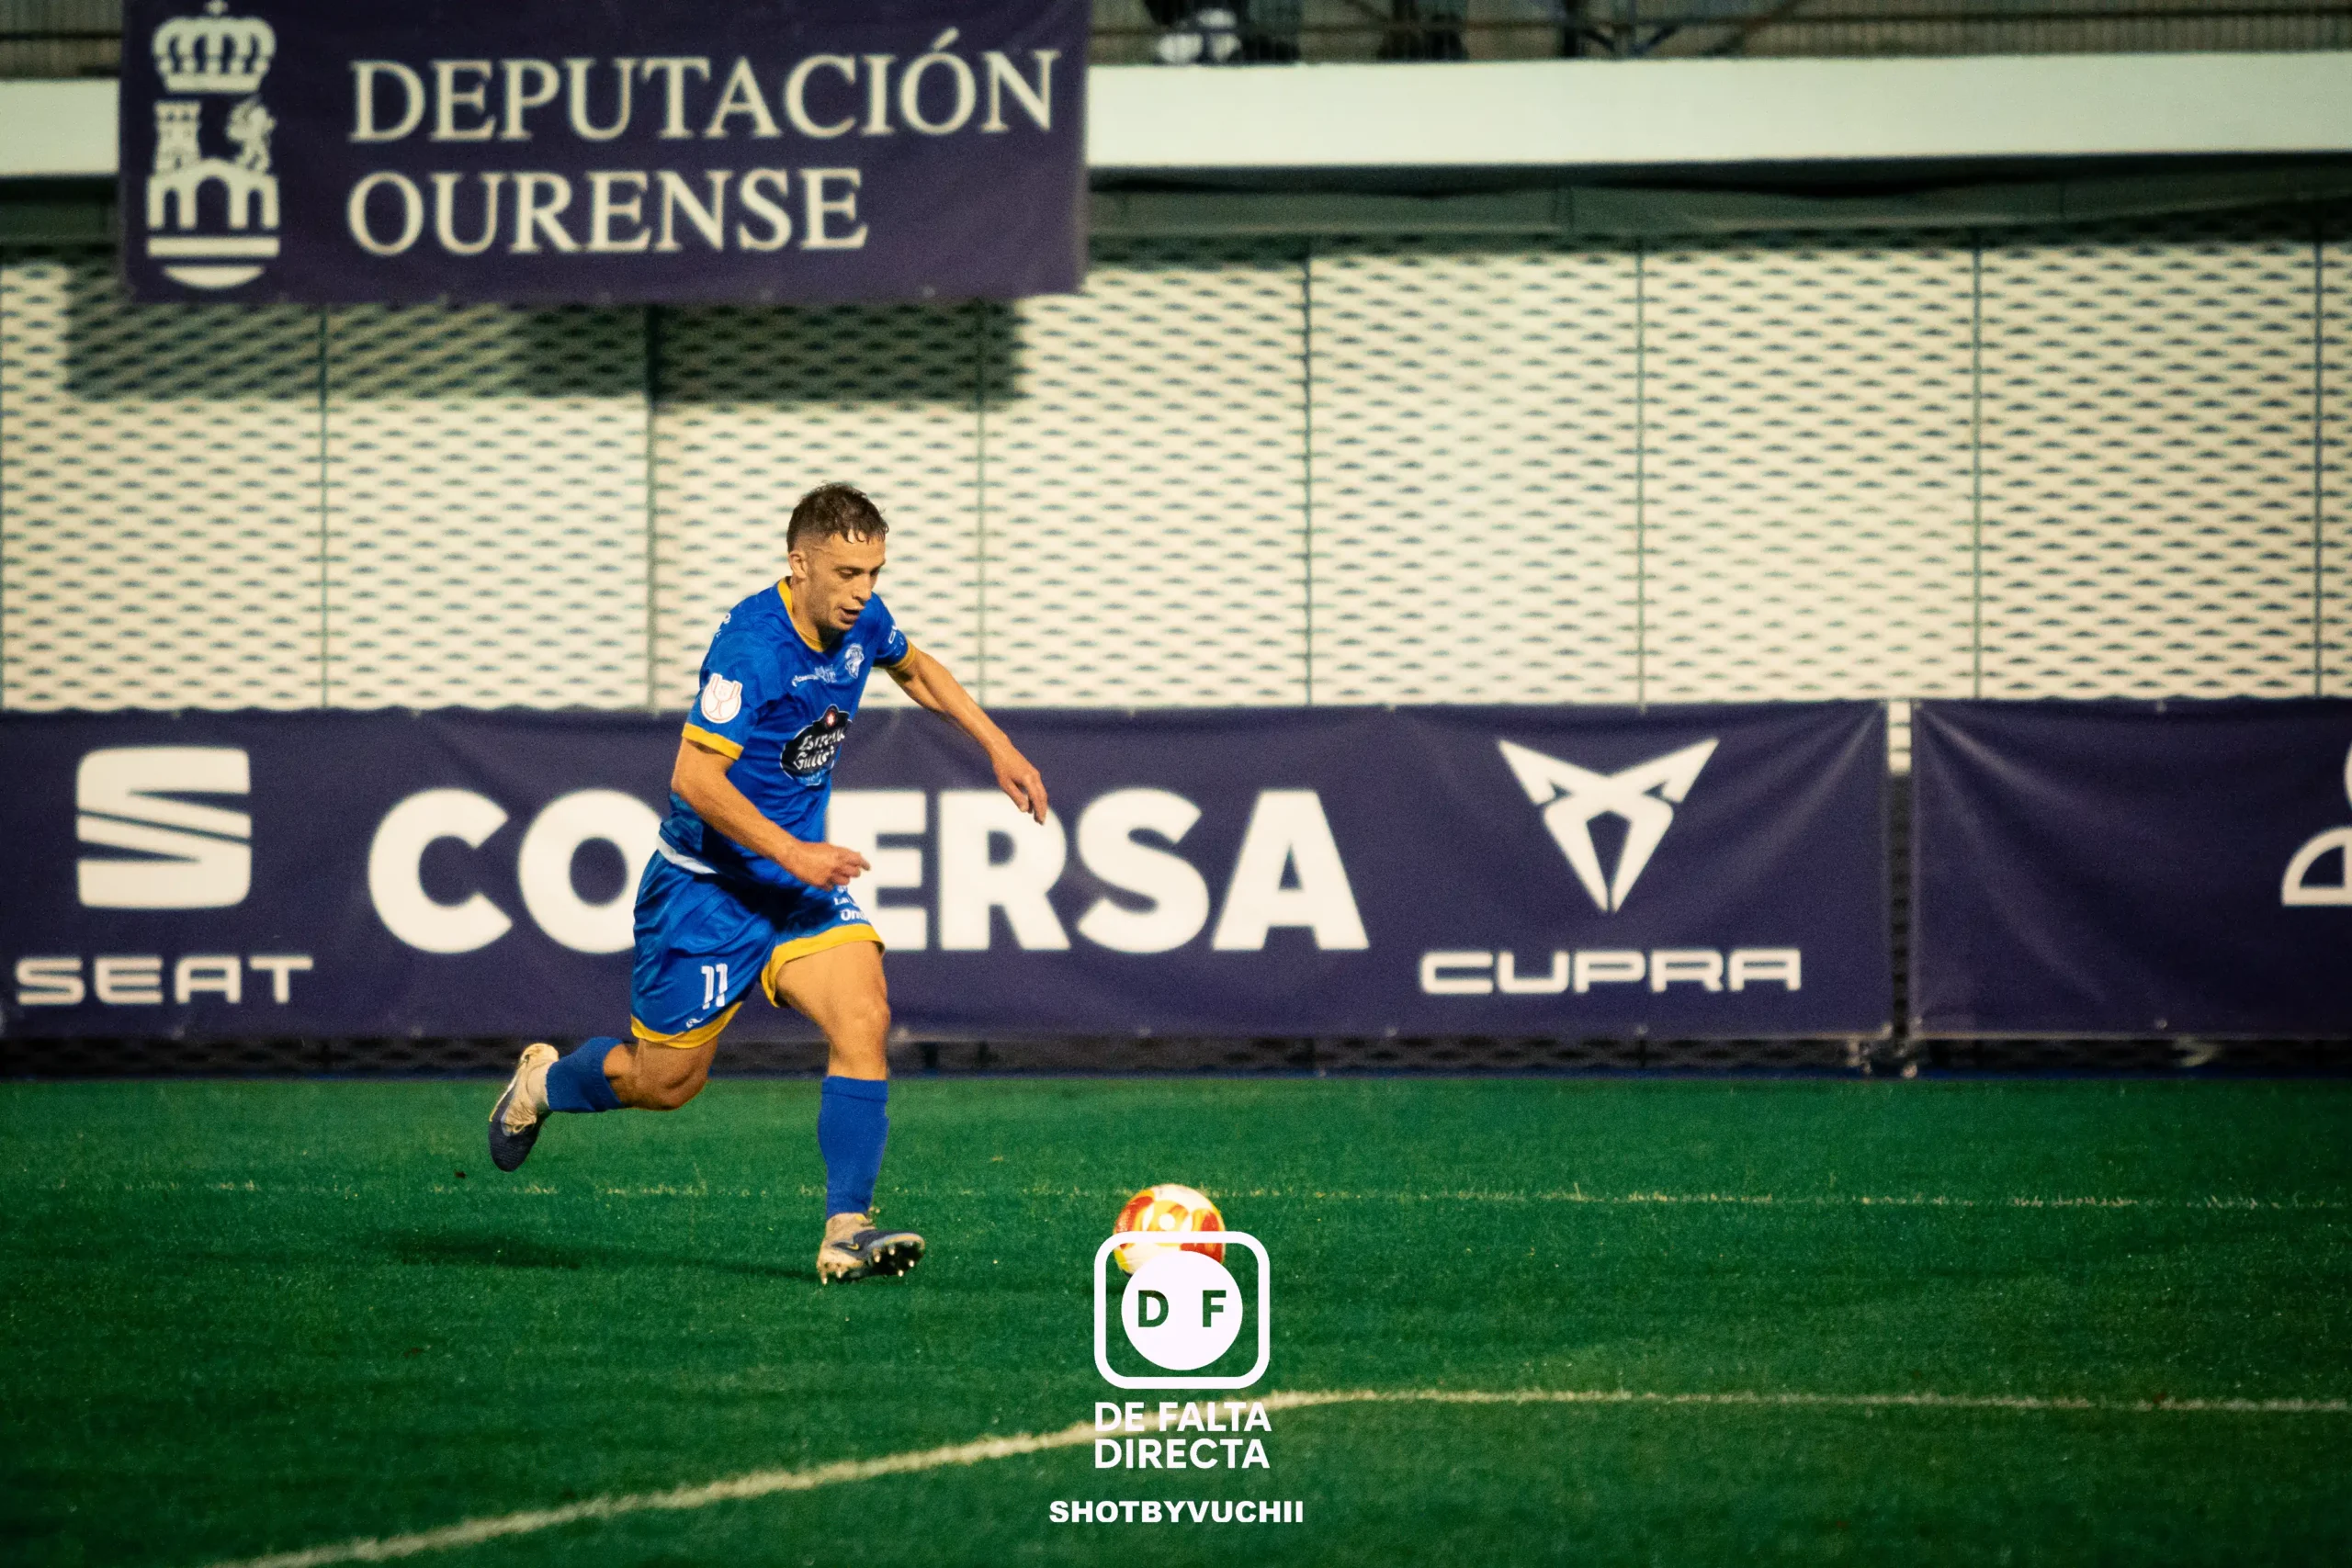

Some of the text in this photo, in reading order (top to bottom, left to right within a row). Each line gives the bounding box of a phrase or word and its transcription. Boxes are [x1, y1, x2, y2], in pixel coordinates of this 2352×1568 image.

[348, 27, 1061, 142] DEPUTACIÓN
[346, 167, 869, 256] OURENSE
[367, 786, 1372, 956] COERSA
[14, 954, 315, 1006] SEAT
[701, 964, 729, 1010] 11
[1418, 947, 1804, 996] CUPRA
